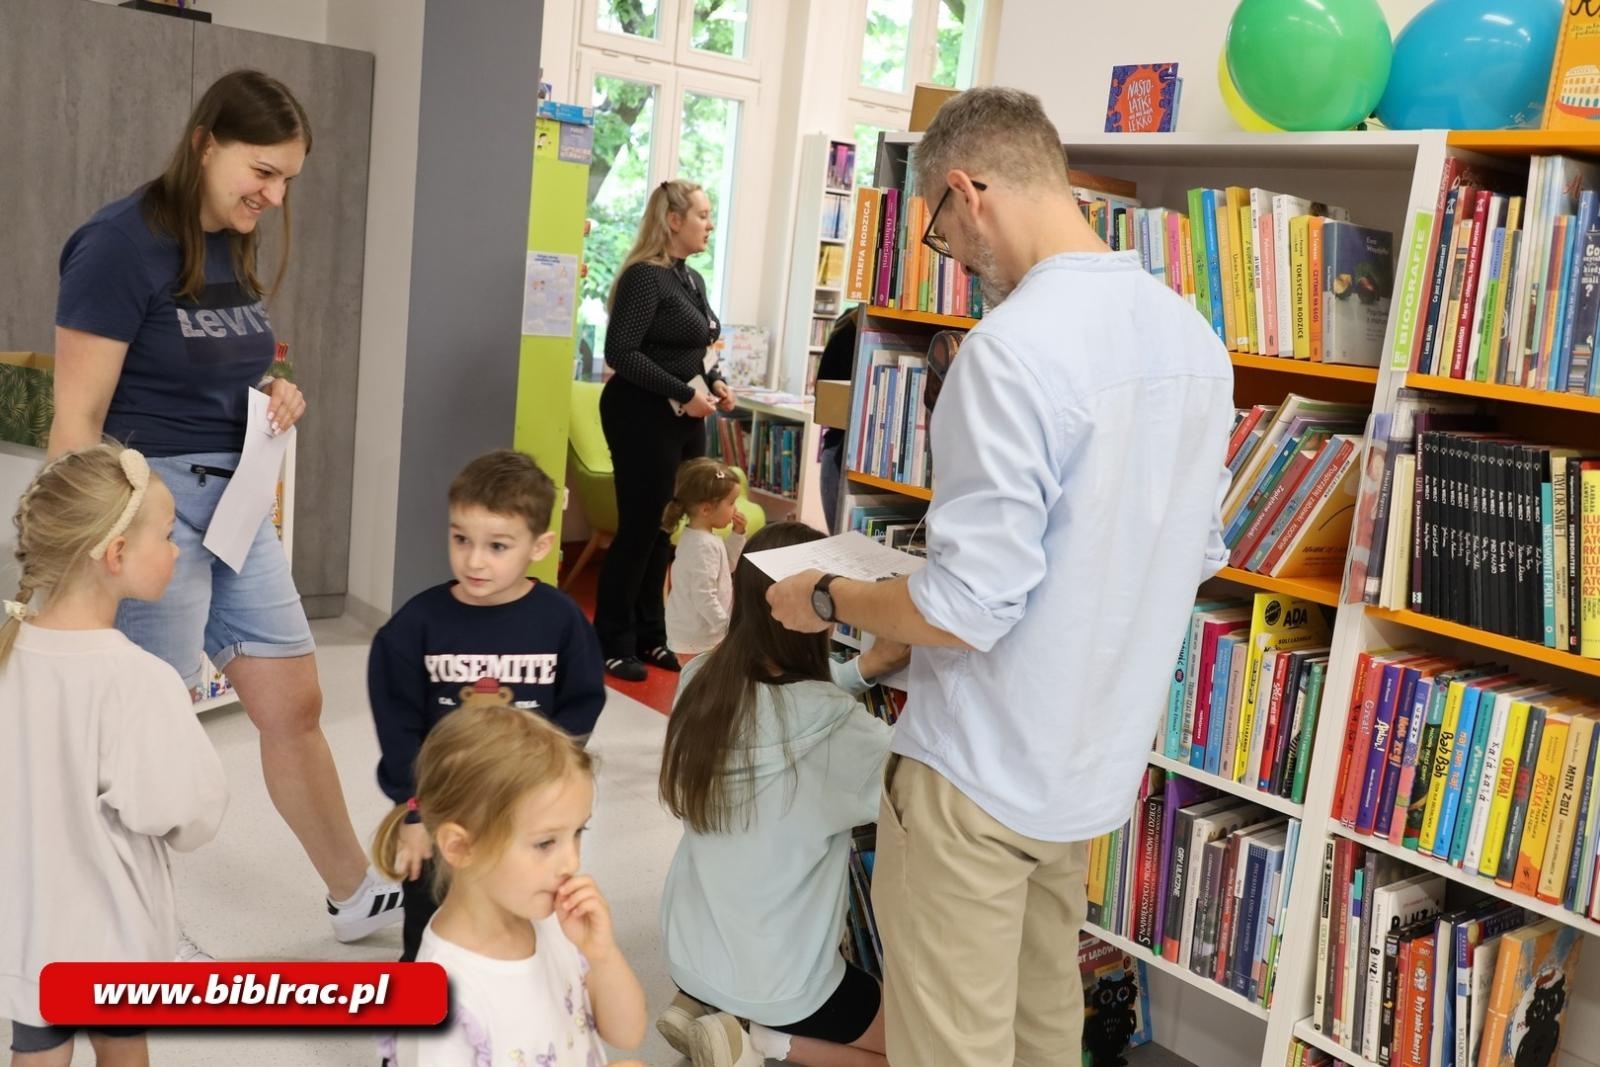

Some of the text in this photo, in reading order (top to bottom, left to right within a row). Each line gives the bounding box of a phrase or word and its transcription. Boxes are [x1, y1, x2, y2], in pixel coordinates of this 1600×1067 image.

[855, 199, 872, 288] STREFA RODZICA
[1399, 229, 1424, 343] BIOGRAFIE
[1431, 295, 1438, 303] Co
[1433, 284, 1441, 295] jest
[1455, 325, 1466, 352] KAMIŃSKI
[1379, 493, 1388, 518] Kopernik
[1554, 473, 1565, 537] TAYLOR SWIFT
[1542, 523, 1553, 581] NIESAMOWITE
[1583, 556, 1599, 565] ILU
[1283, 608, 1307, 626] ADA
[424, 654, 558, 684] YOSEMITE
[1358, 699, 1374, 736] Great!
[1431, 755, 1451, 779] Bah
[1563, 764, 1577, 791] MAN
[1530, 771, 1549, 808] POLSKA
[1148, 802, 1156, 827] DZIECI
[1144, 837, 1153, 881] PROBLEMÓW
[1172, 846, 1184, 896] GRY ULICZNE
[1139, 882, 1149, 935] NAJWIĘKSZYCH
[1410, 995, 1425, 1064] Były sobie Ameryki
